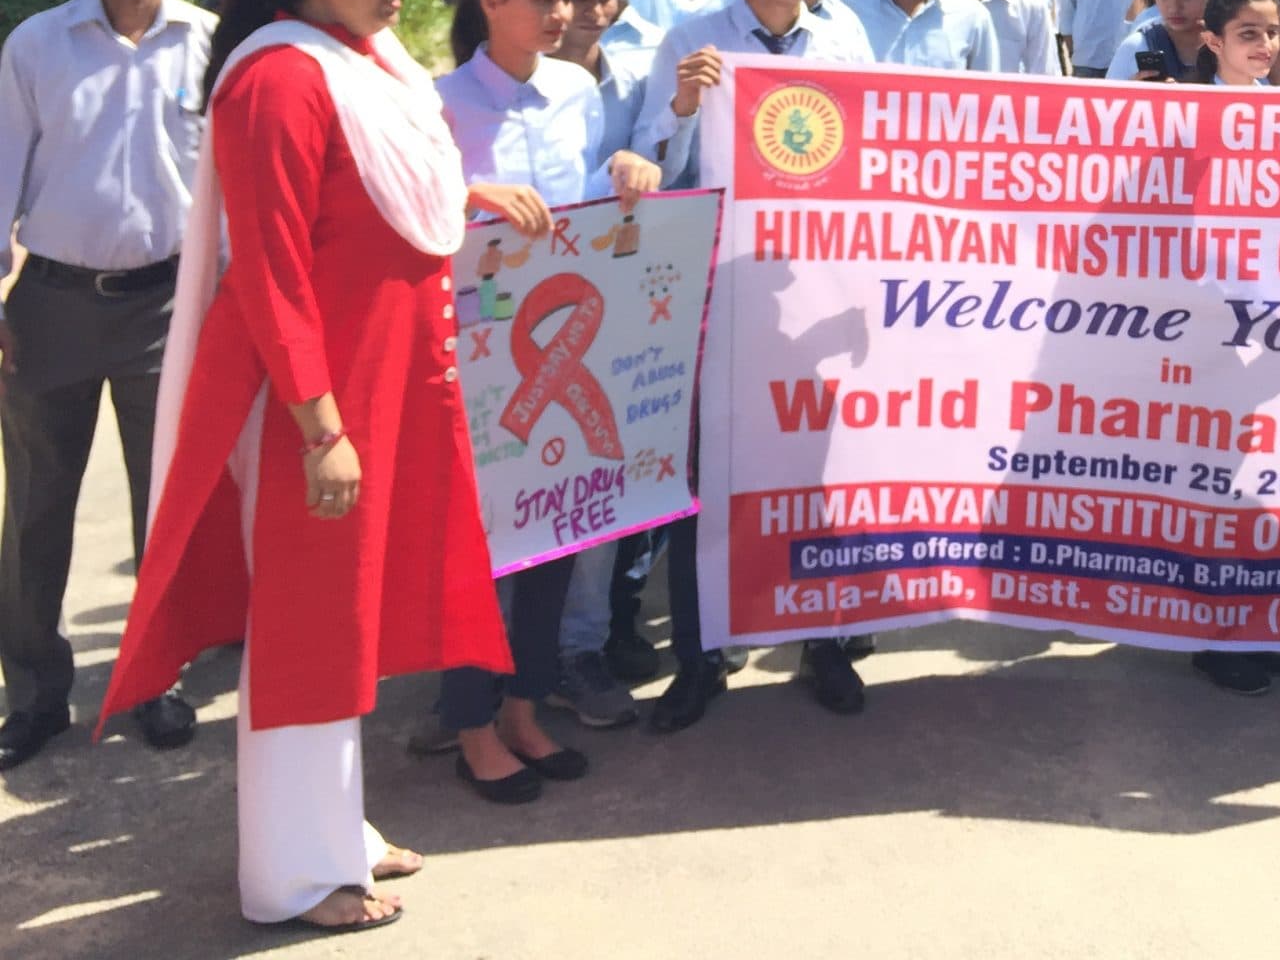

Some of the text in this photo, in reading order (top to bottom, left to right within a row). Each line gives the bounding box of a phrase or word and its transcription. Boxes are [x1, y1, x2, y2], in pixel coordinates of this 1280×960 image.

[863, 90, 1198, 149] HIMALAYAN
[859, 149, 1192, 205] PROFESSIONAL
[755, 210, 1016, 266] HIMALAYAN
[1036, 223, 1259, 280] INSTITUTE
[880, 278, 1190, 341] Welcome
[1161, 357, 1191, 384] in
[770, 378, 979, 433] World
[513, 463, 626, 528] STAY DRUG
[988, 446, 1178, 485] September
[1189, 462, 1242, 499] 25,
[552, 504, 616, 545] FREE
[760, 486, 1009, 536] HIMALAYAN
[1025, 491, 1238, 549] INSTITUTE
[800, 541, 904, 569] Courses
[912, 536, 1004, 561] offered
[1031, 546, 1185, 583] D.Pharmacy,
[774, 570, 976, 616] Kala-Amb,
[991, 572, 1090, 610] Distt.
[1105, 586, 1252, 628] Sirmour
